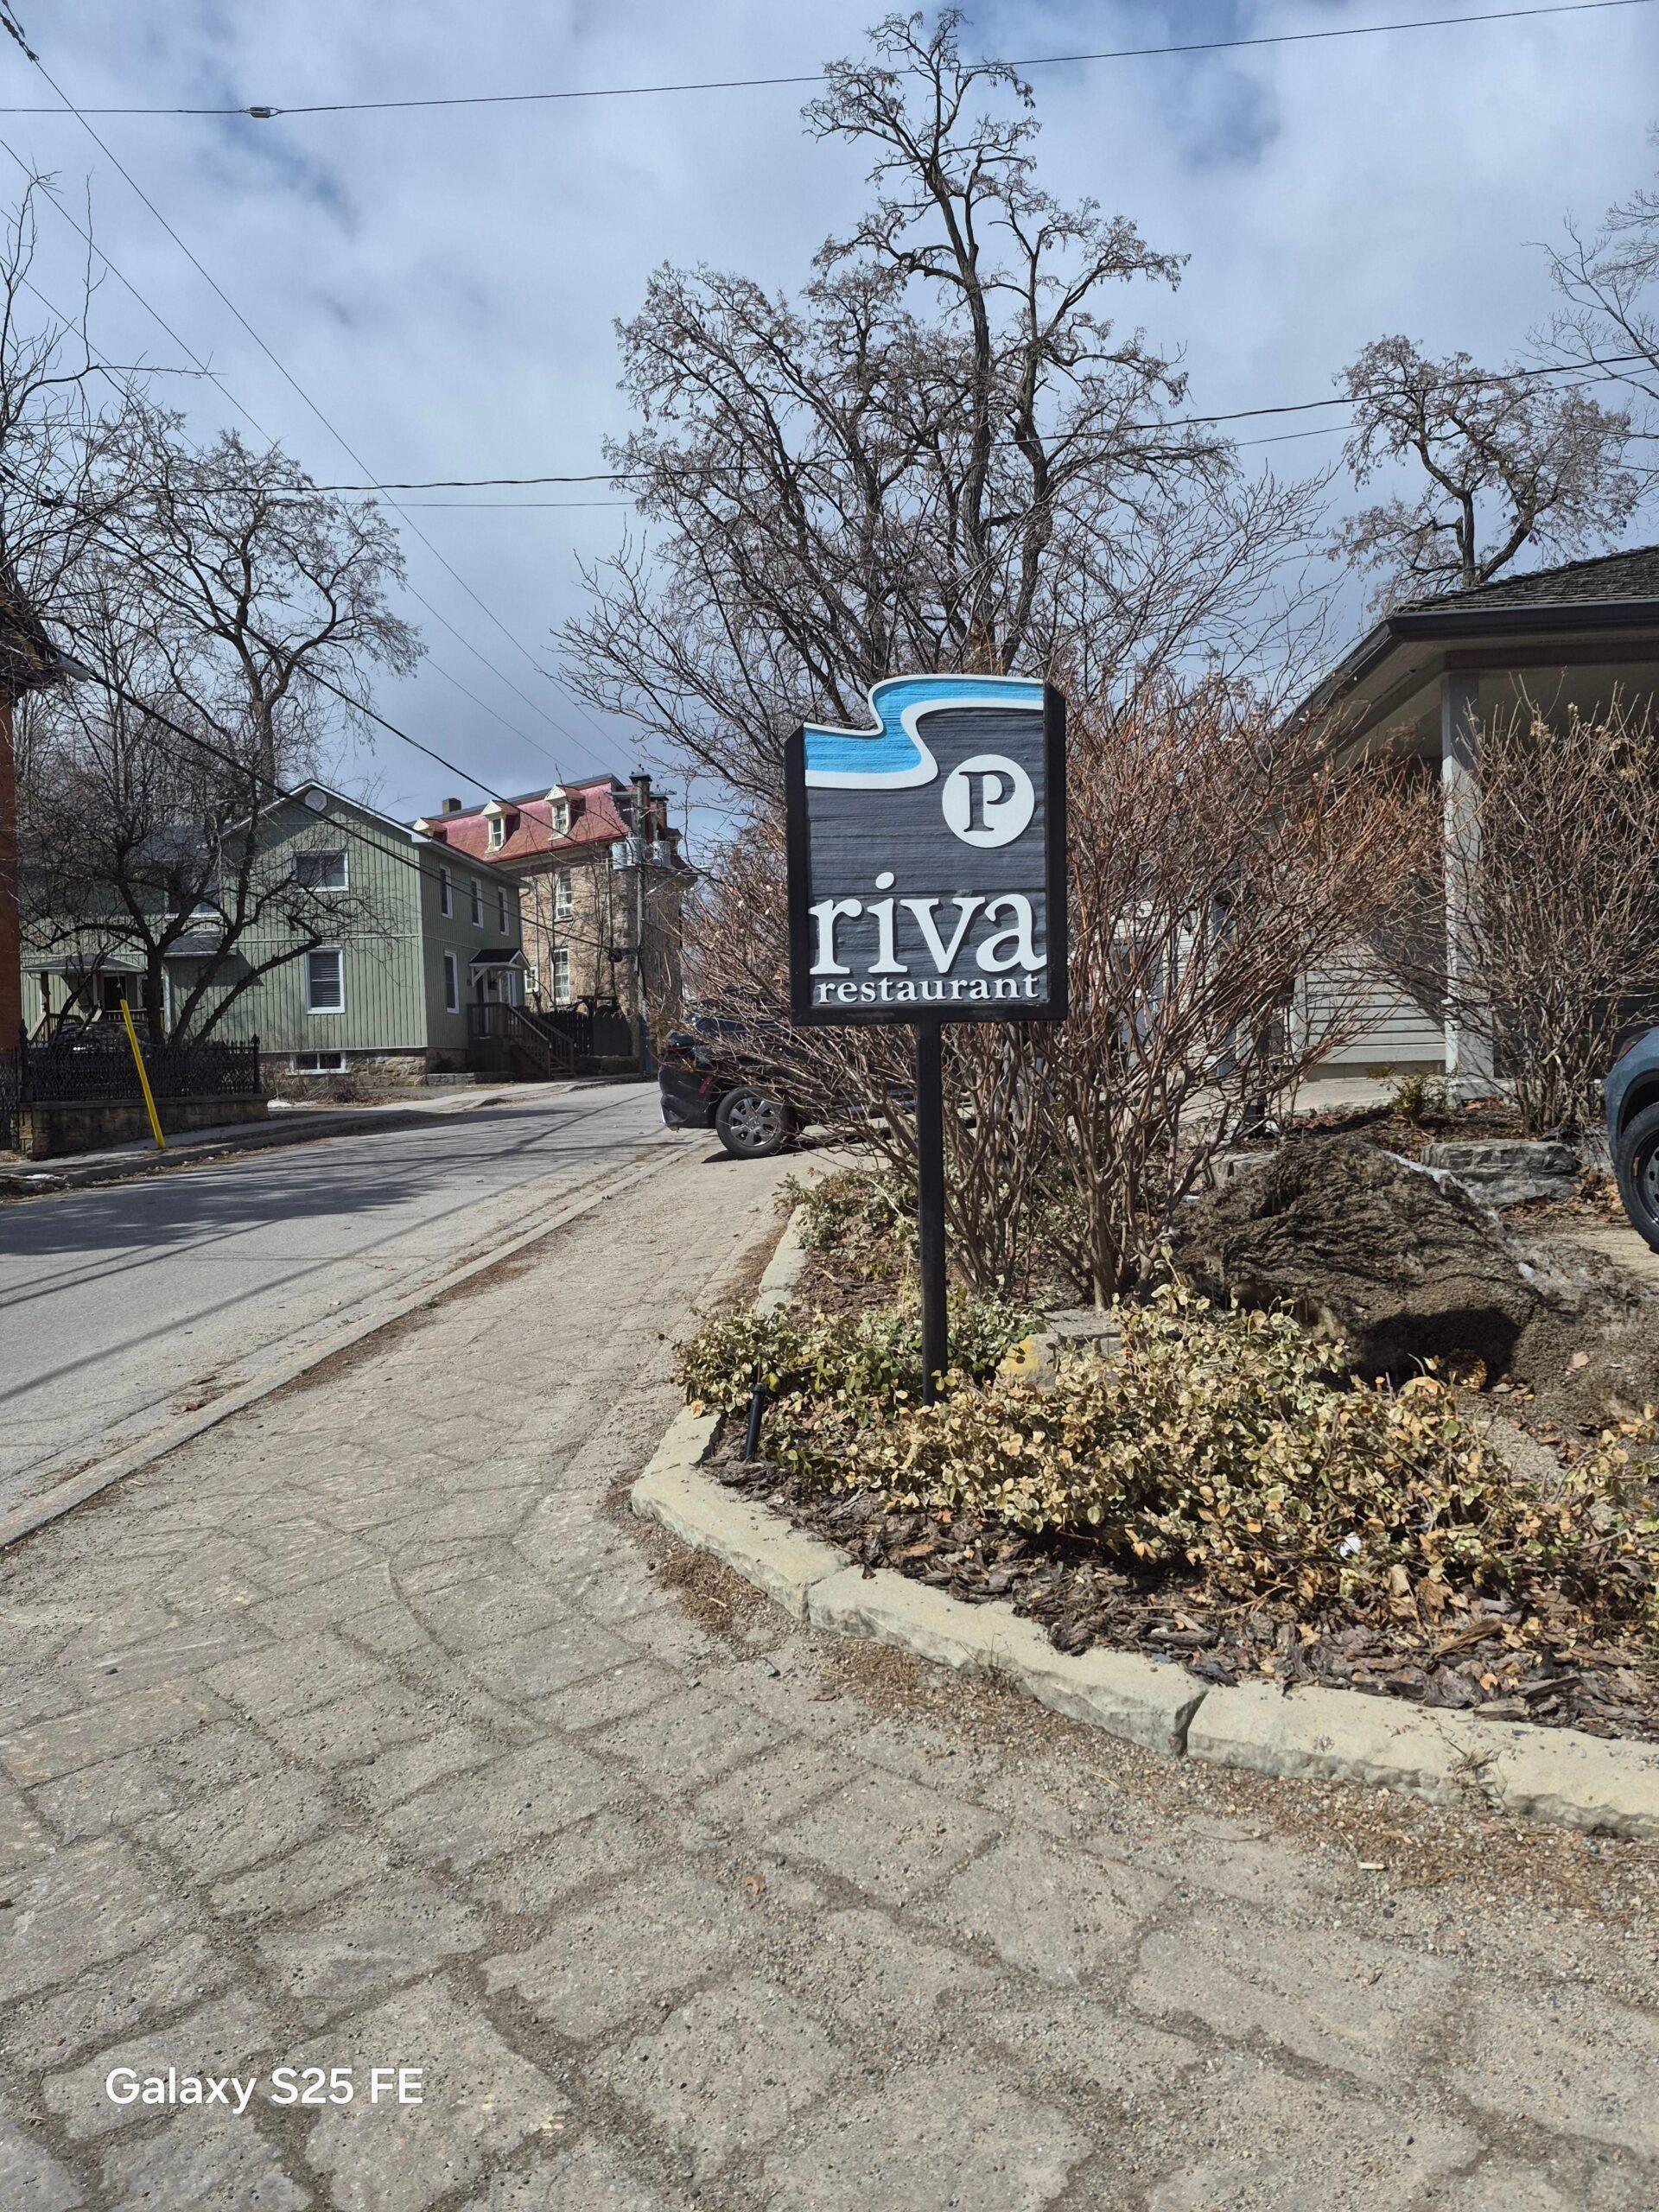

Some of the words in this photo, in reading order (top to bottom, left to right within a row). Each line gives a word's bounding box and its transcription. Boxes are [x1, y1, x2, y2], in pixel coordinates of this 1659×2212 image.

[958, 770, 1016, 833] P
[808, 872, 1048, 975] riva
[817, 974, 1039, 1004] restaurant
